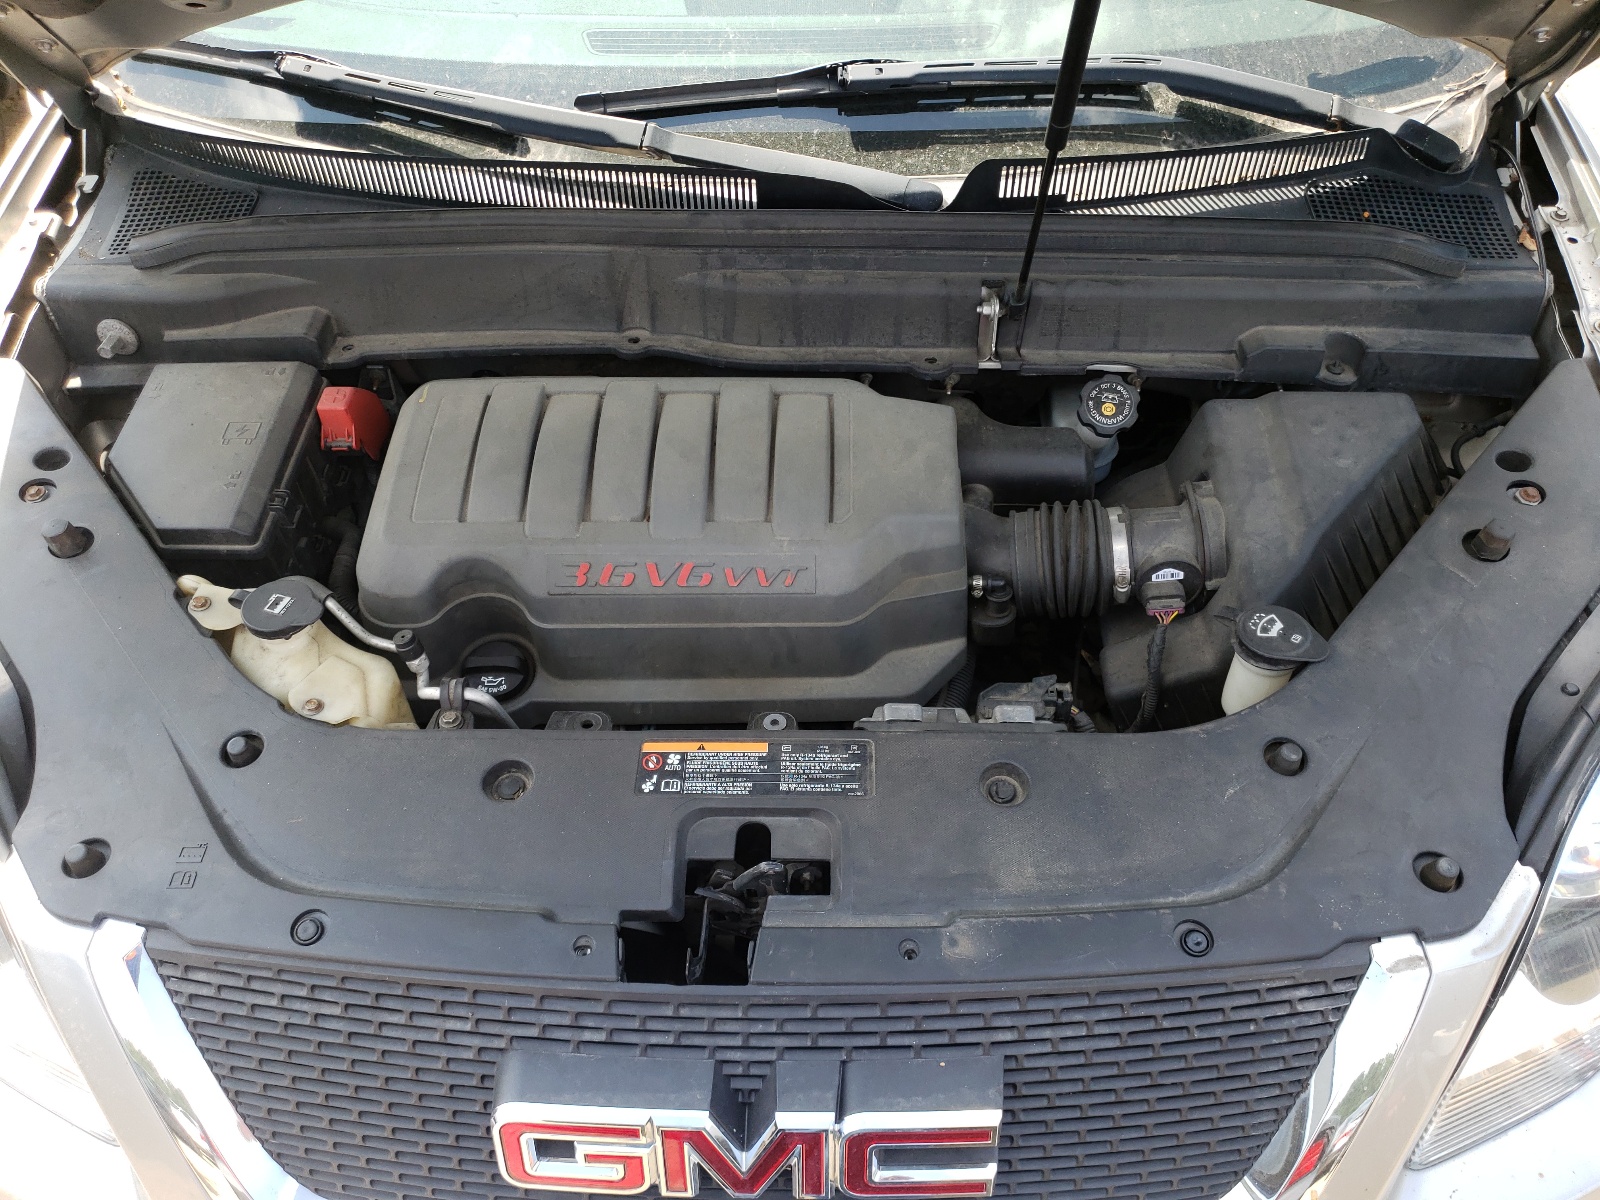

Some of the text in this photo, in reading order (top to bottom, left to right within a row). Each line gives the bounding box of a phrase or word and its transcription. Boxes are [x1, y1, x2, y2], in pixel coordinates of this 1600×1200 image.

[1090, 410, 1125, 424] WARNING
[1116, 385, 1130, 399] BRAKE
[555, 562, 808, 588] 3.6 V6 VVT
[492, 1101, 1002, 1198] GMC
